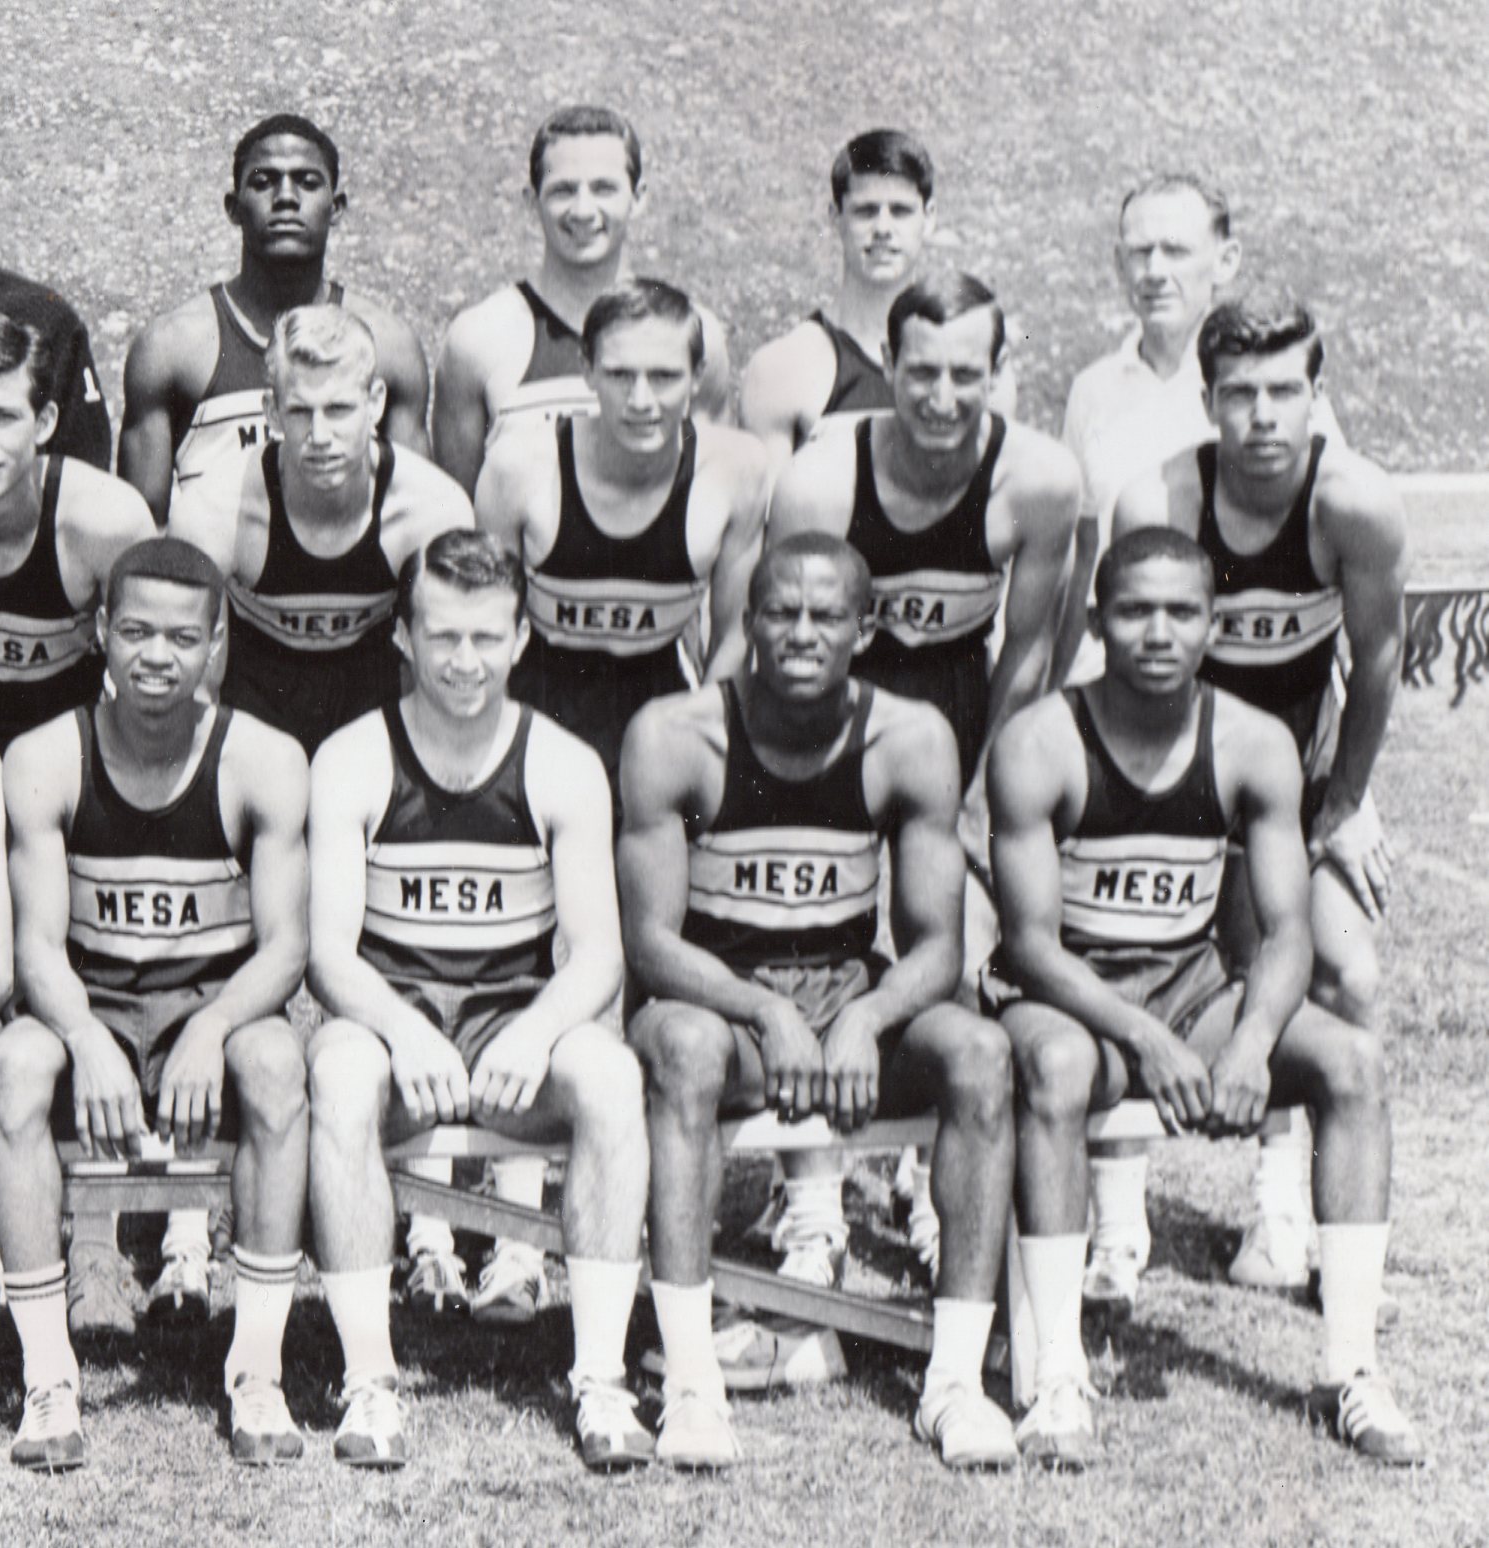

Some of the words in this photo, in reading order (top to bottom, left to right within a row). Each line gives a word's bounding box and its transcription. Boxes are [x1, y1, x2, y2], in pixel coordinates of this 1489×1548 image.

[279, 607, 372, 633] MESA
[556, 602, 656, 631] MESA
[868, 594, 944, 625] ESA
[1212, 612, 1301, 638] ESA
[399, 876, 504, 912] MESA
[735, 862, 839, 896] MESA
[1093, 868, 1197, 905] MESA
[96, 890, 201, 926] MESA
